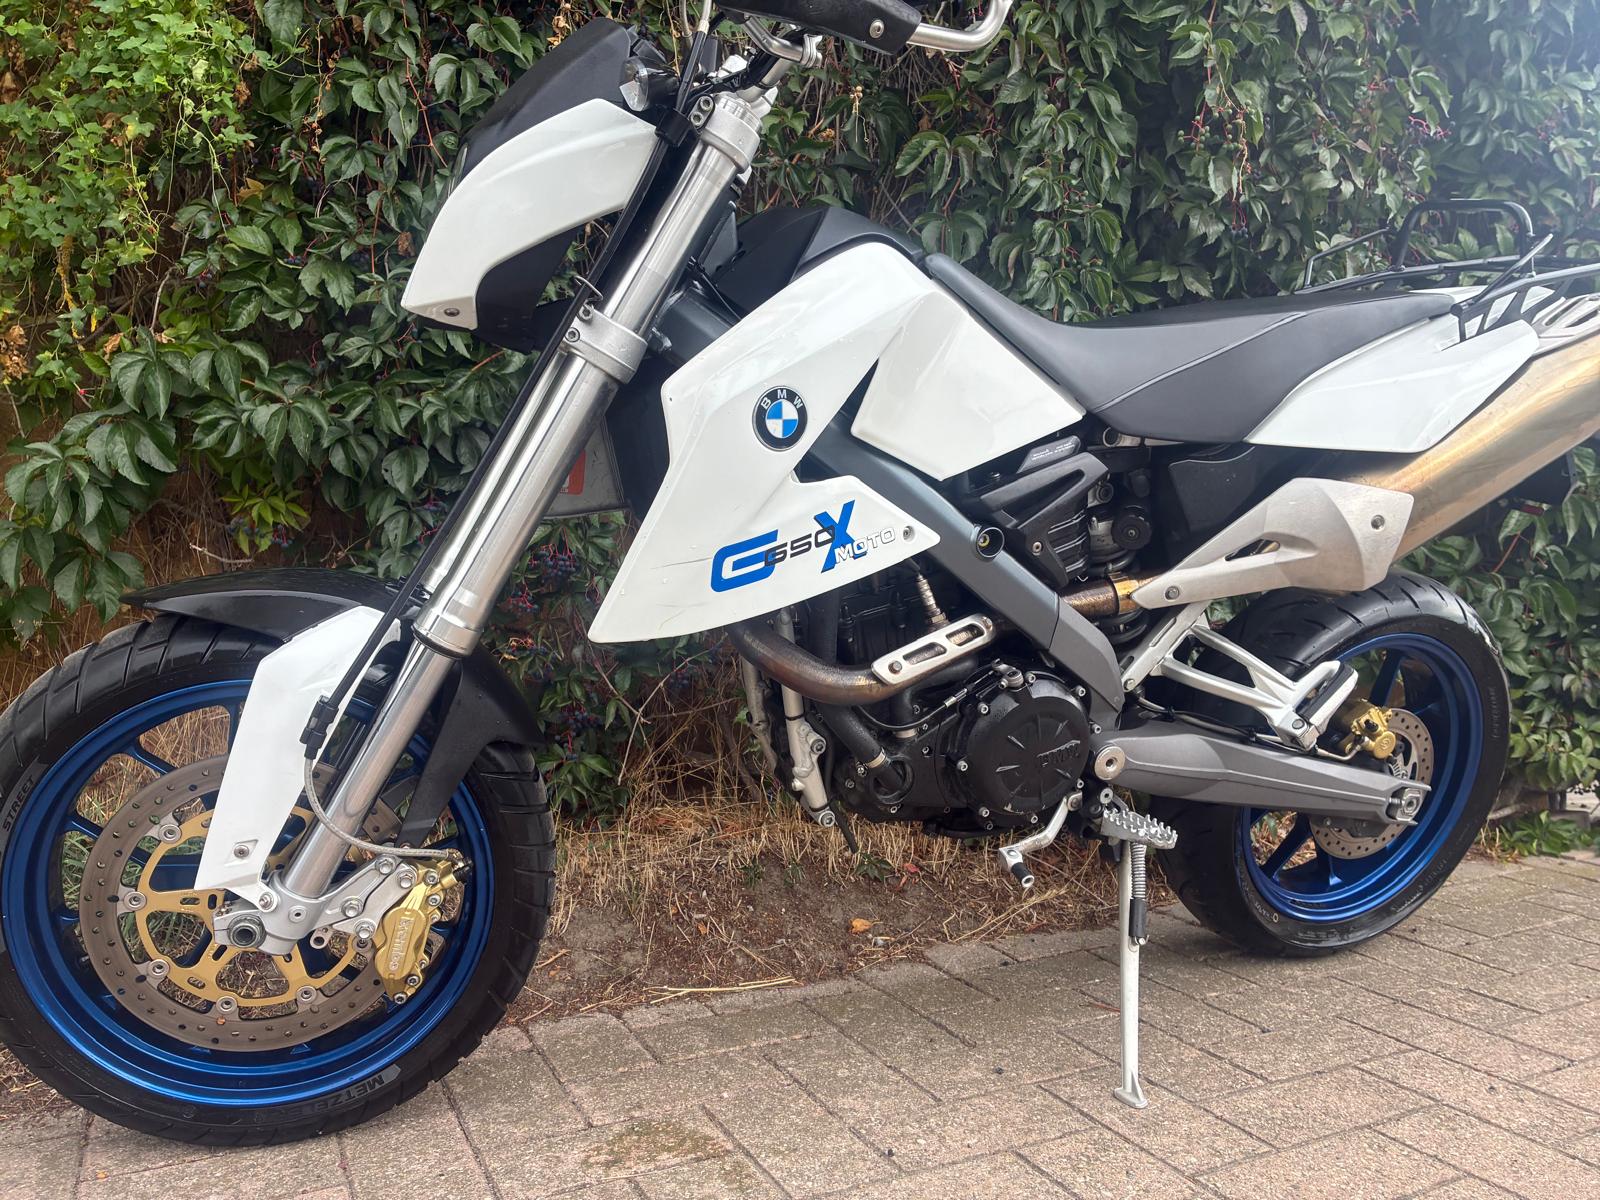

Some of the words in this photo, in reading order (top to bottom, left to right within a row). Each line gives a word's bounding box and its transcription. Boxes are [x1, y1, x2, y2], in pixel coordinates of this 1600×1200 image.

[761, 389, 804, 409] BMW
[835, 527, 896, 565] MOTO
[3, 775, 36, 832] STREET
